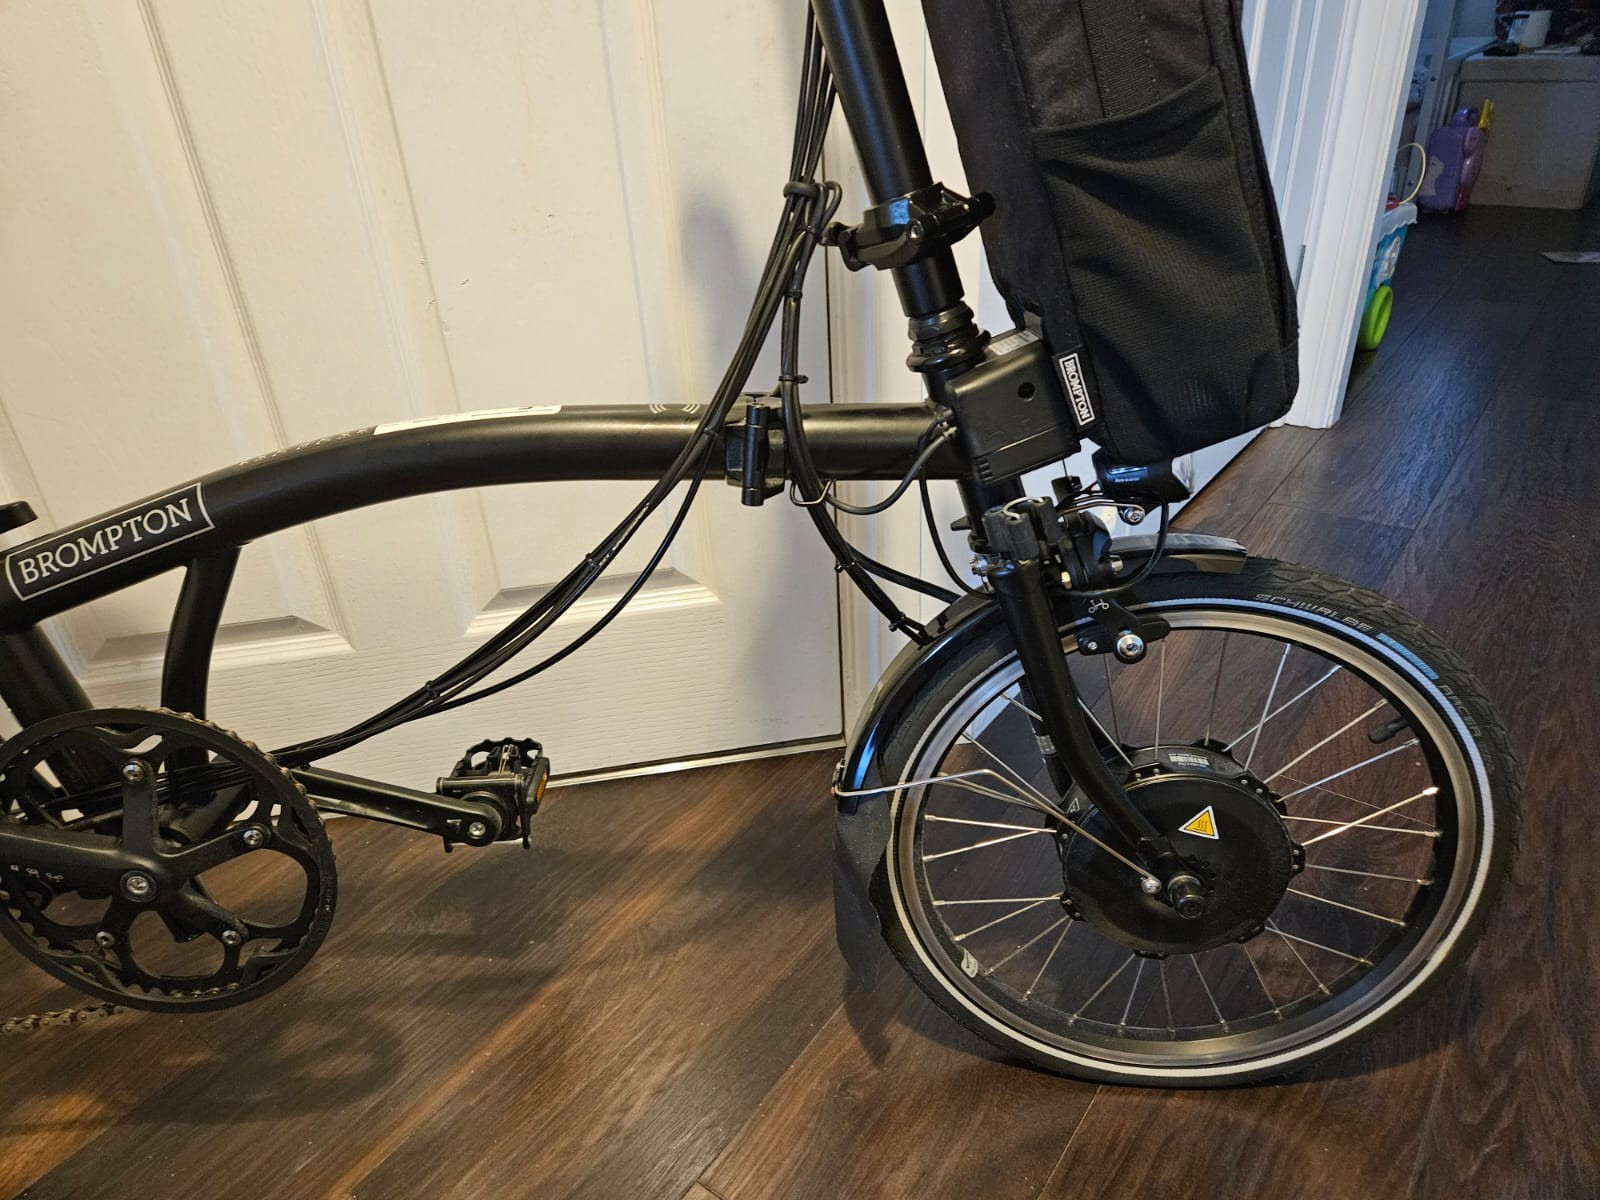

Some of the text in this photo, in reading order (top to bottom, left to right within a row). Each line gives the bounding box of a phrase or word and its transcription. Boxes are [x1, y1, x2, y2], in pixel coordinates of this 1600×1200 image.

[1063, 358, 1091, 420] BROMPTON
[18, 498, 193, 584] BROMPTON
[1254, 593, 1374, 632] SCHWALBE
